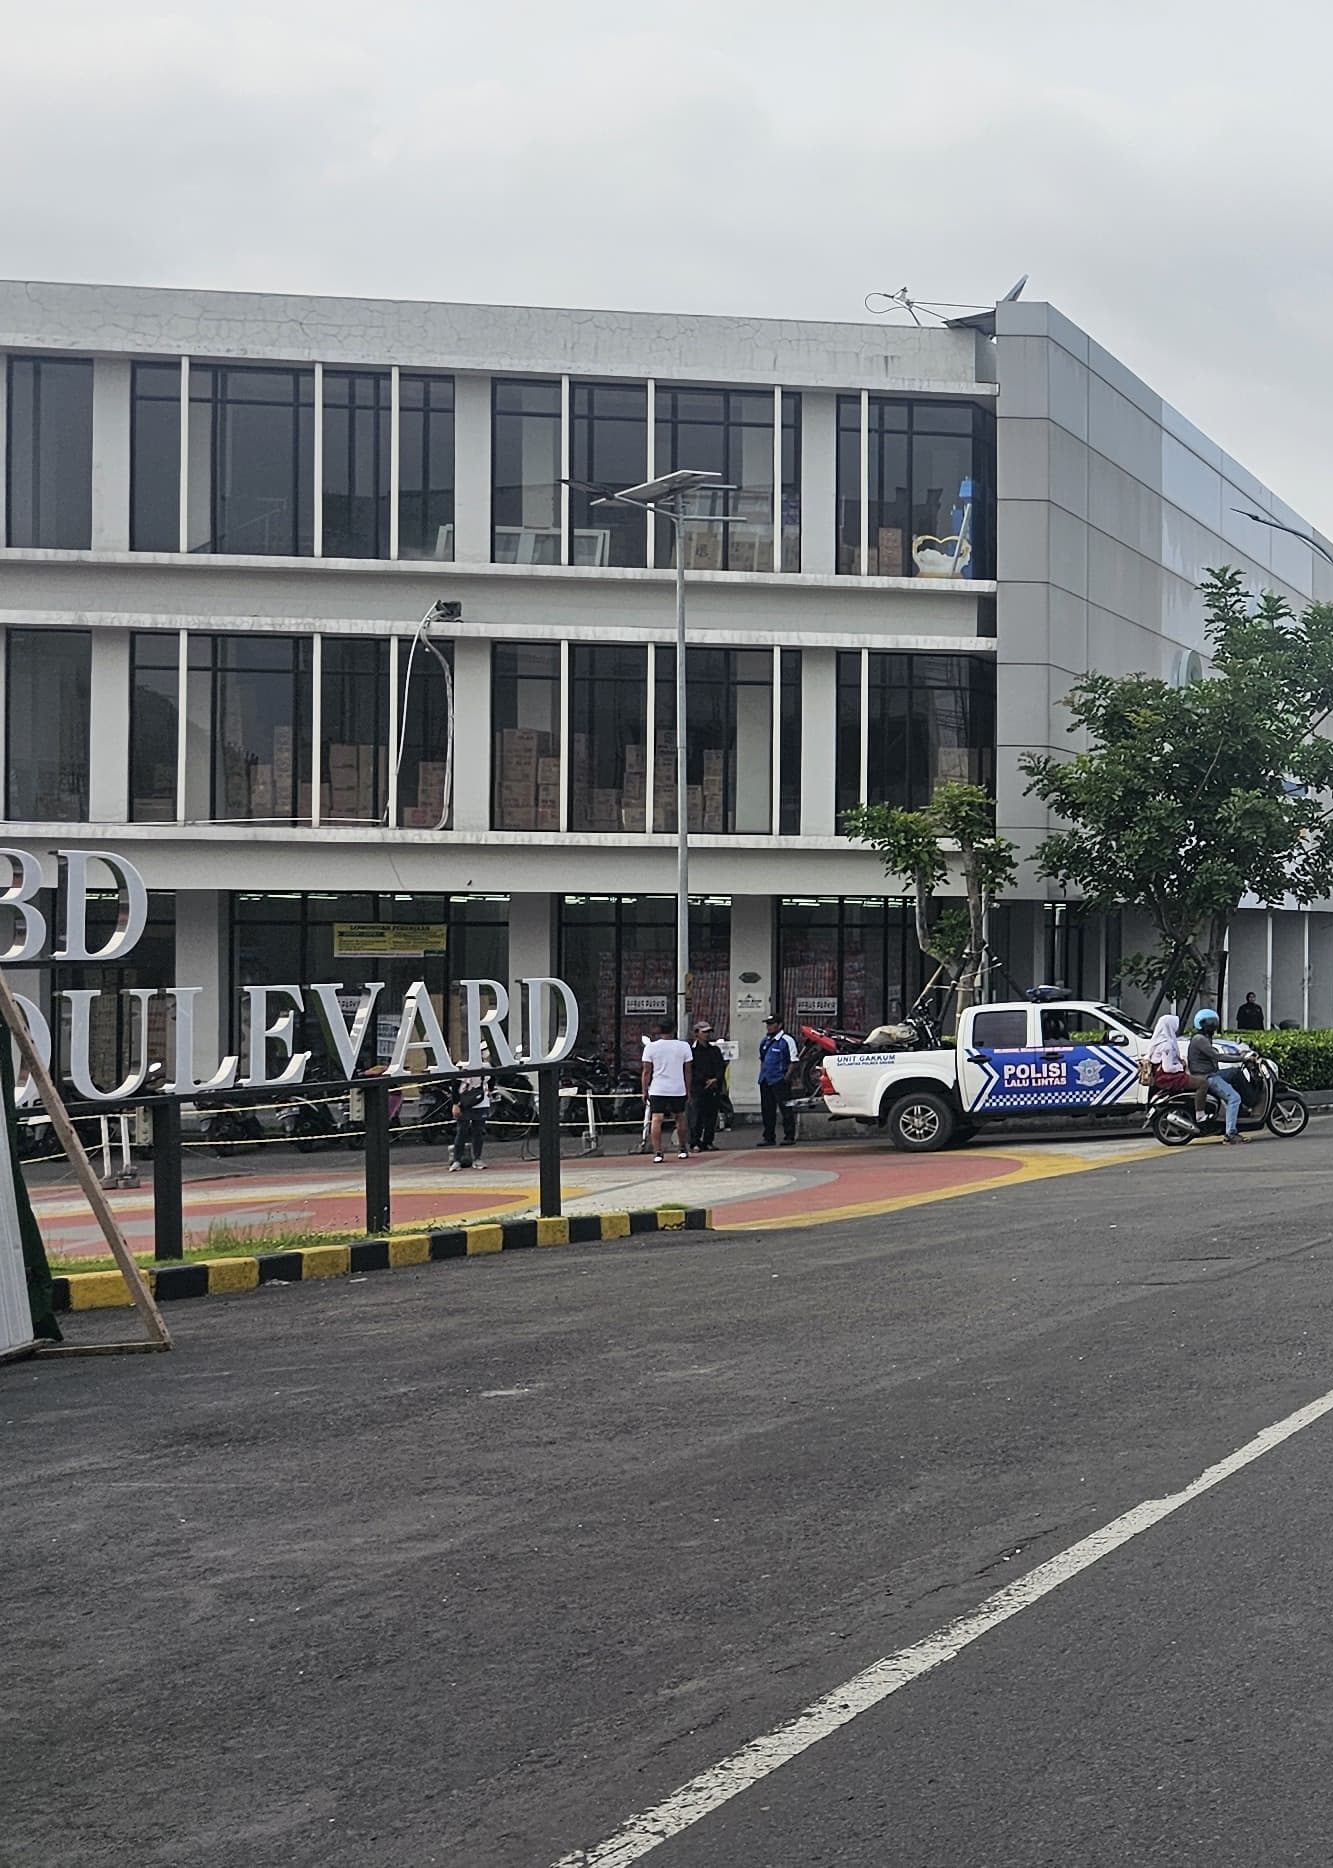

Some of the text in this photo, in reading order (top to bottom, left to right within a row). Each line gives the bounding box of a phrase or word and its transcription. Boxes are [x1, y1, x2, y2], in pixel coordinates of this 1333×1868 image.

[837, 1054, 896, 1063] UNIT GAKKUM
[1003, 1062, 1067, 1079] POLISI
[1004, 1077, 1067, 1088] LALU LINTAS
